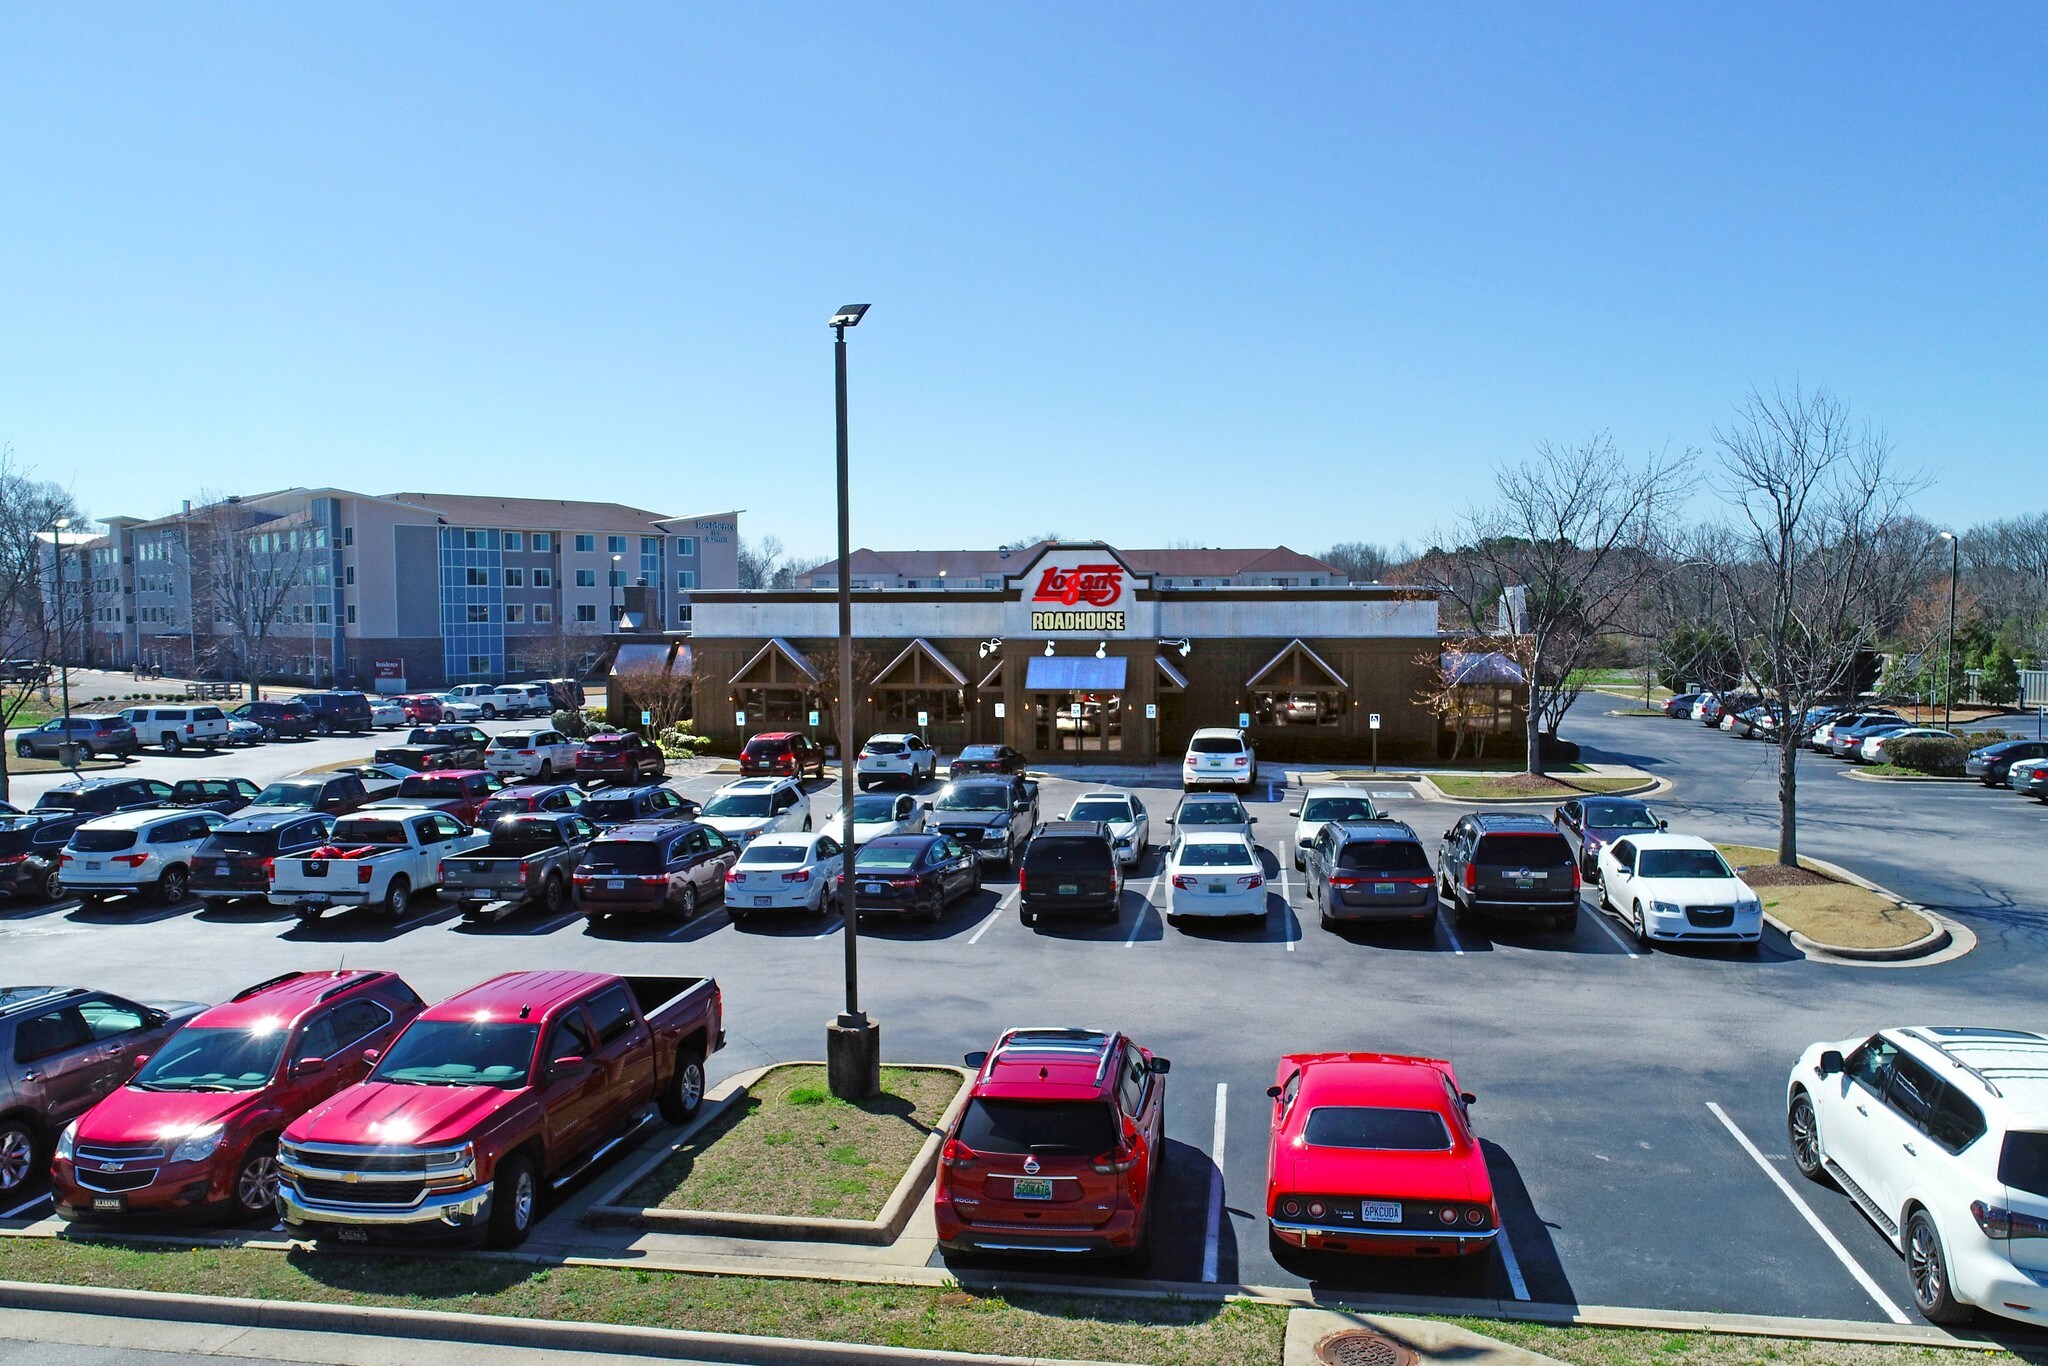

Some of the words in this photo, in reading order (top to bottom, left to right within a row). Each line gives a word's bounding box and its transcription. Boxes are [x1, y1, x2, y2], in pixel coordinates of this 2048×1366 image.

[697, 521, 737, 531] Residence
[1032, 611, 1125, 631] ROADHOUSE
[954, 1197, 980, 1205] ROGUE
[1364, 1206, 1399, 1218] 6PKCUDA
